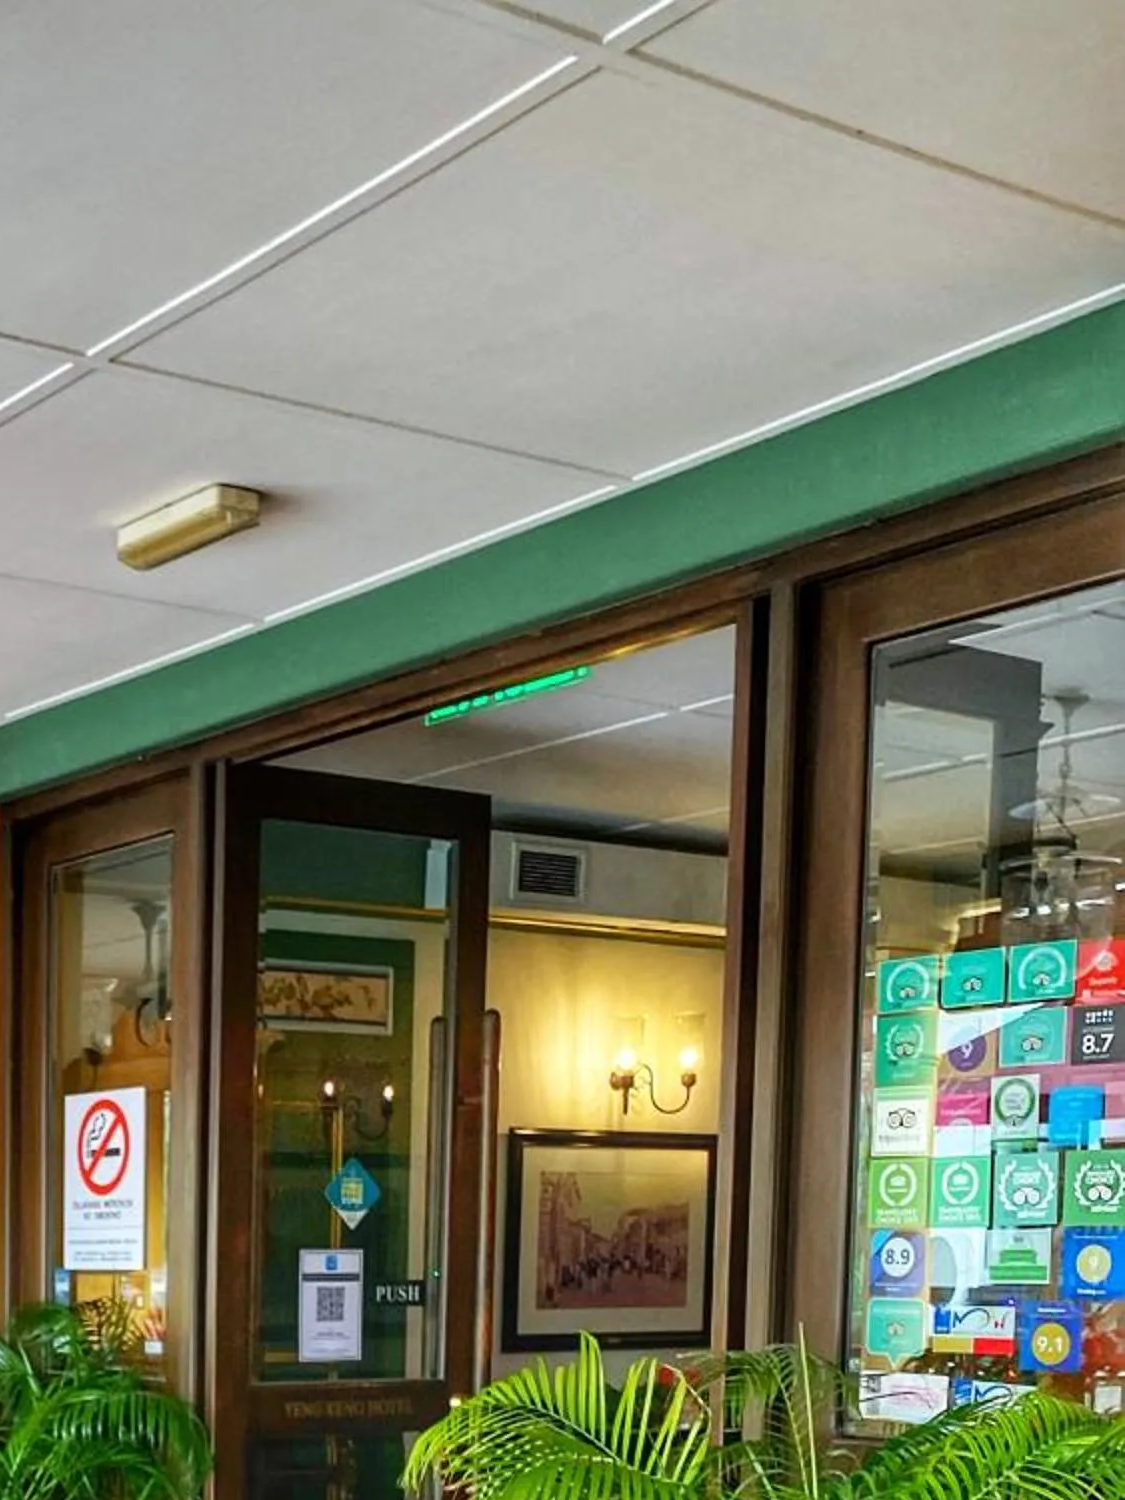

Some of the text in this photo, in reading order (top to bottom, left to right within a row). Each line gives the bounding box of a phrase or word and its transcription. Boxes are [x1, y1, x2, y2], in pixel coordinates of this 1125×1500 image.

[1082, 1033, 1115, 1054] 8.7
[884, 1248, 910, 1266] 8.9
[375, 1285, 421, 1303] PUSH
[1036, 1336, 1062, 1353] 9.1
